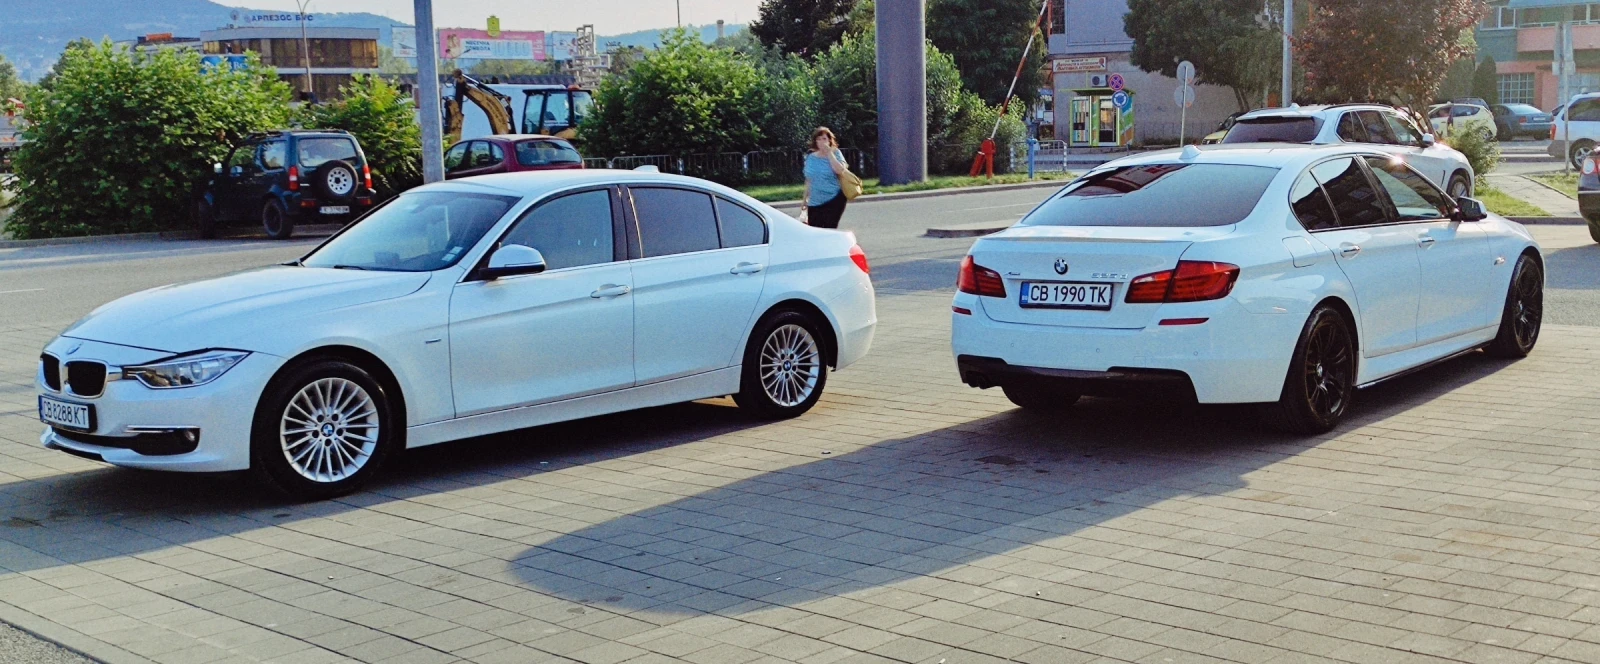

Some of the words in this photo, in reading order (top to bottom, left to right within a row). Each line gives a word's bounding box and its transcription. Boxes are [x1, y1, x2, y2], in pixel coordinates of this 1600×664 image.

[251, 14, 292, 22] АРПЕЗОС
[1053, 285, 1086, 303] 1990
[1089, 286, 1108, 303] TK
[53, 404, 72, 423] 8288
[74, 407, 87, 425] KT
